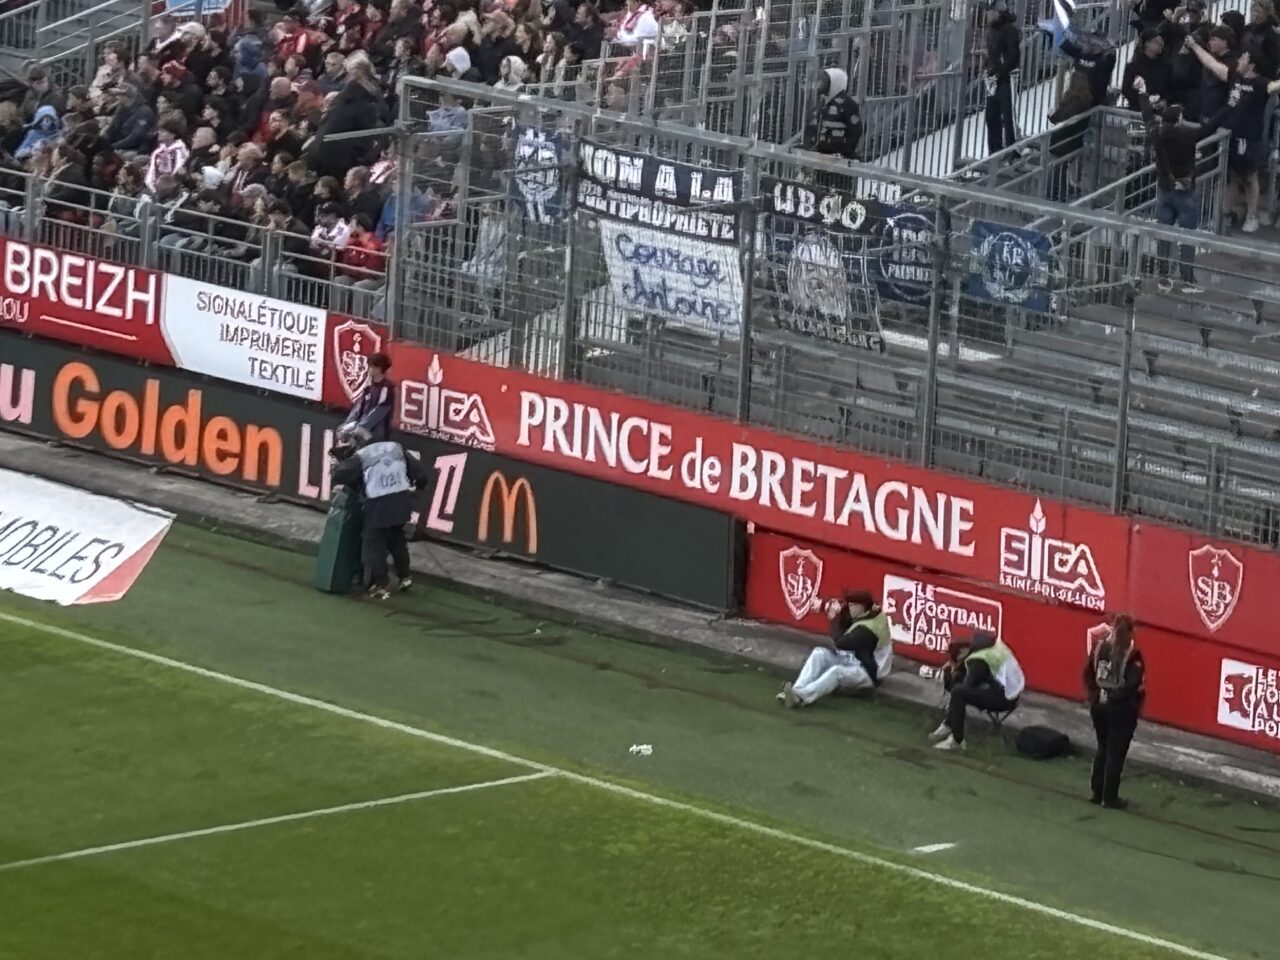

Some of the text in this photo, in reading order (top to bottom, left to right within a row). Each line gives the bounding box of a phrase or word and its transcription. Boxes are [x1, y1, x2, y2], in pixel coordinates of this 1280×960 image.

[4, 241, 157, 325] BREIZH
[0, 296, 29, 323] OU
[196, 290, 319, 337] SIGNALÉTIQUE
[219, 322, 317, 364] IMPRIMERIE
[248, 355, 316, 391] TEXTILE
[52, 360, 282, 488] Golden
[516, 390, 674, 482] PRINCE
[680, 435, 722, 495] de
[729, 441, 976, 557] BRETAGNE
[915, 580, 935, 600] LE
[914, 599, 996, 632] FOOTBALL
[1257, 667, 1278, 689] LE
